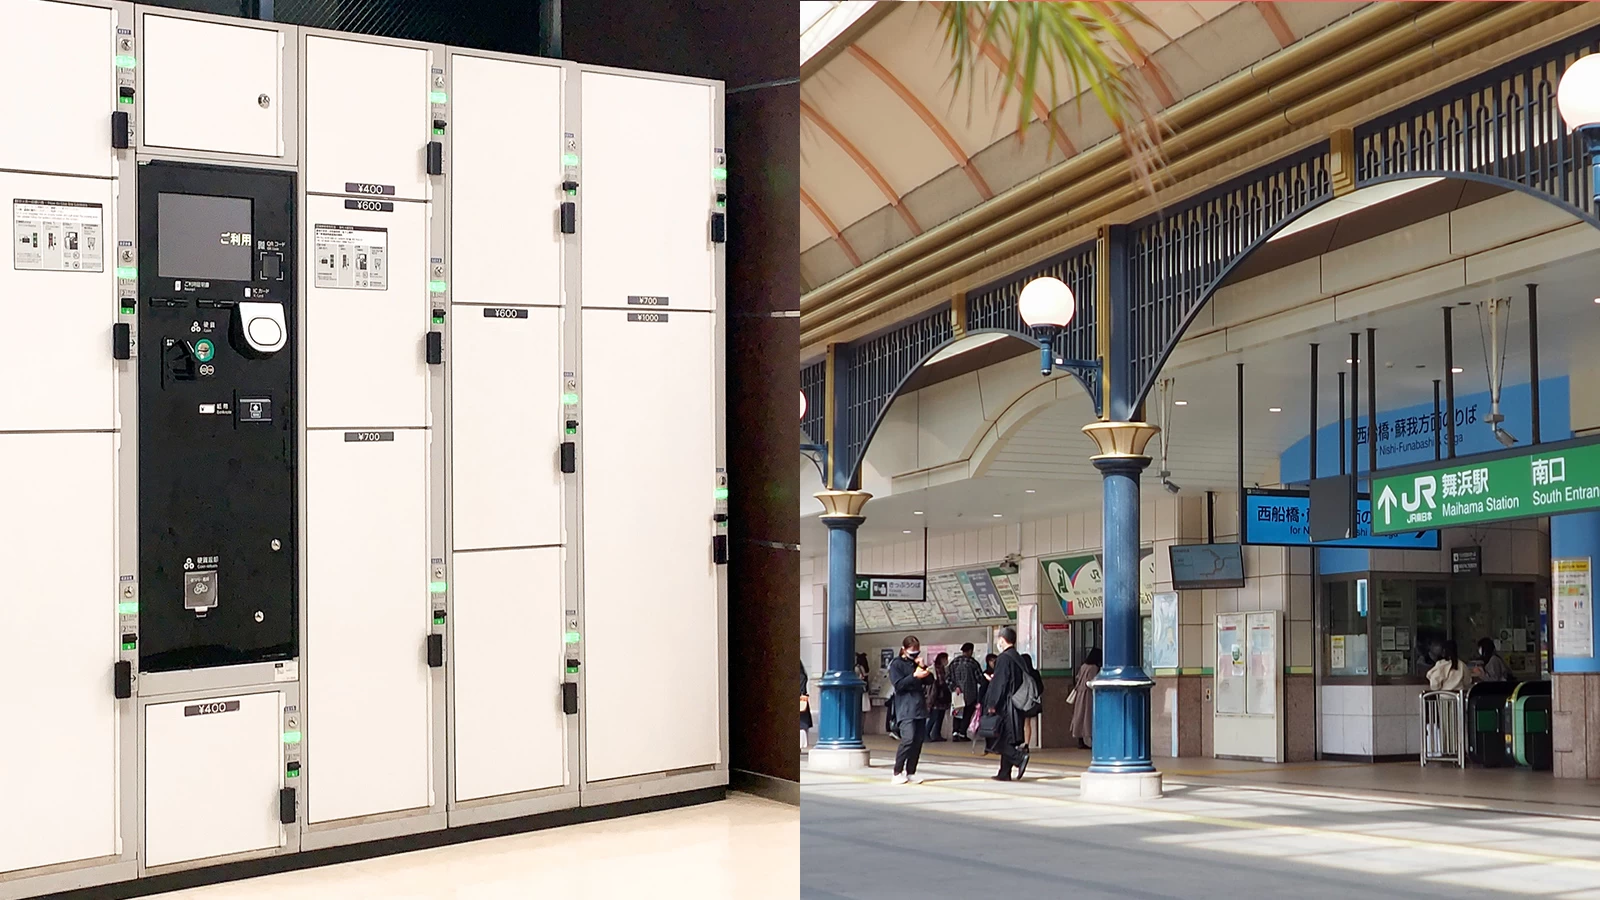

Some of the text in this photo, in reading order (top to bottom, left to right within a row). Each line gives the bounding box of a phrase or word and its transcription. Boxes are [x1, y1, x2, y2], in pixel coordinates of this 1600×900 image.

[358, 183, 383, 194] ¥400
[357, 200, 382, 211] ¥600
[220, 232, 252, 246] ご利用
[640, 296, 658, 305] ¥700
[495, 308, 518, 318] ¥600
[638, 313, 659, 322] ¥1000
[358, 432, 380, 441] ¥700
[1379, 433, 1464, 455] Nishi-Funabashi Sga
[1531, 456, 1566, 487] 南口
[1441, 467, 1489, 499] 舞浜駅
[1402, 475, 1437, 512] JR
[1532, 488, 1563, 506] South
[1442, 495, 1520, 517] Maihama Station
[1290, 525, 1300, 535] for
[856, 580, 869, 589] JR
[888, 581, 922, 589] きっぷうりば
[199, 702, 226, 715] ¥400
